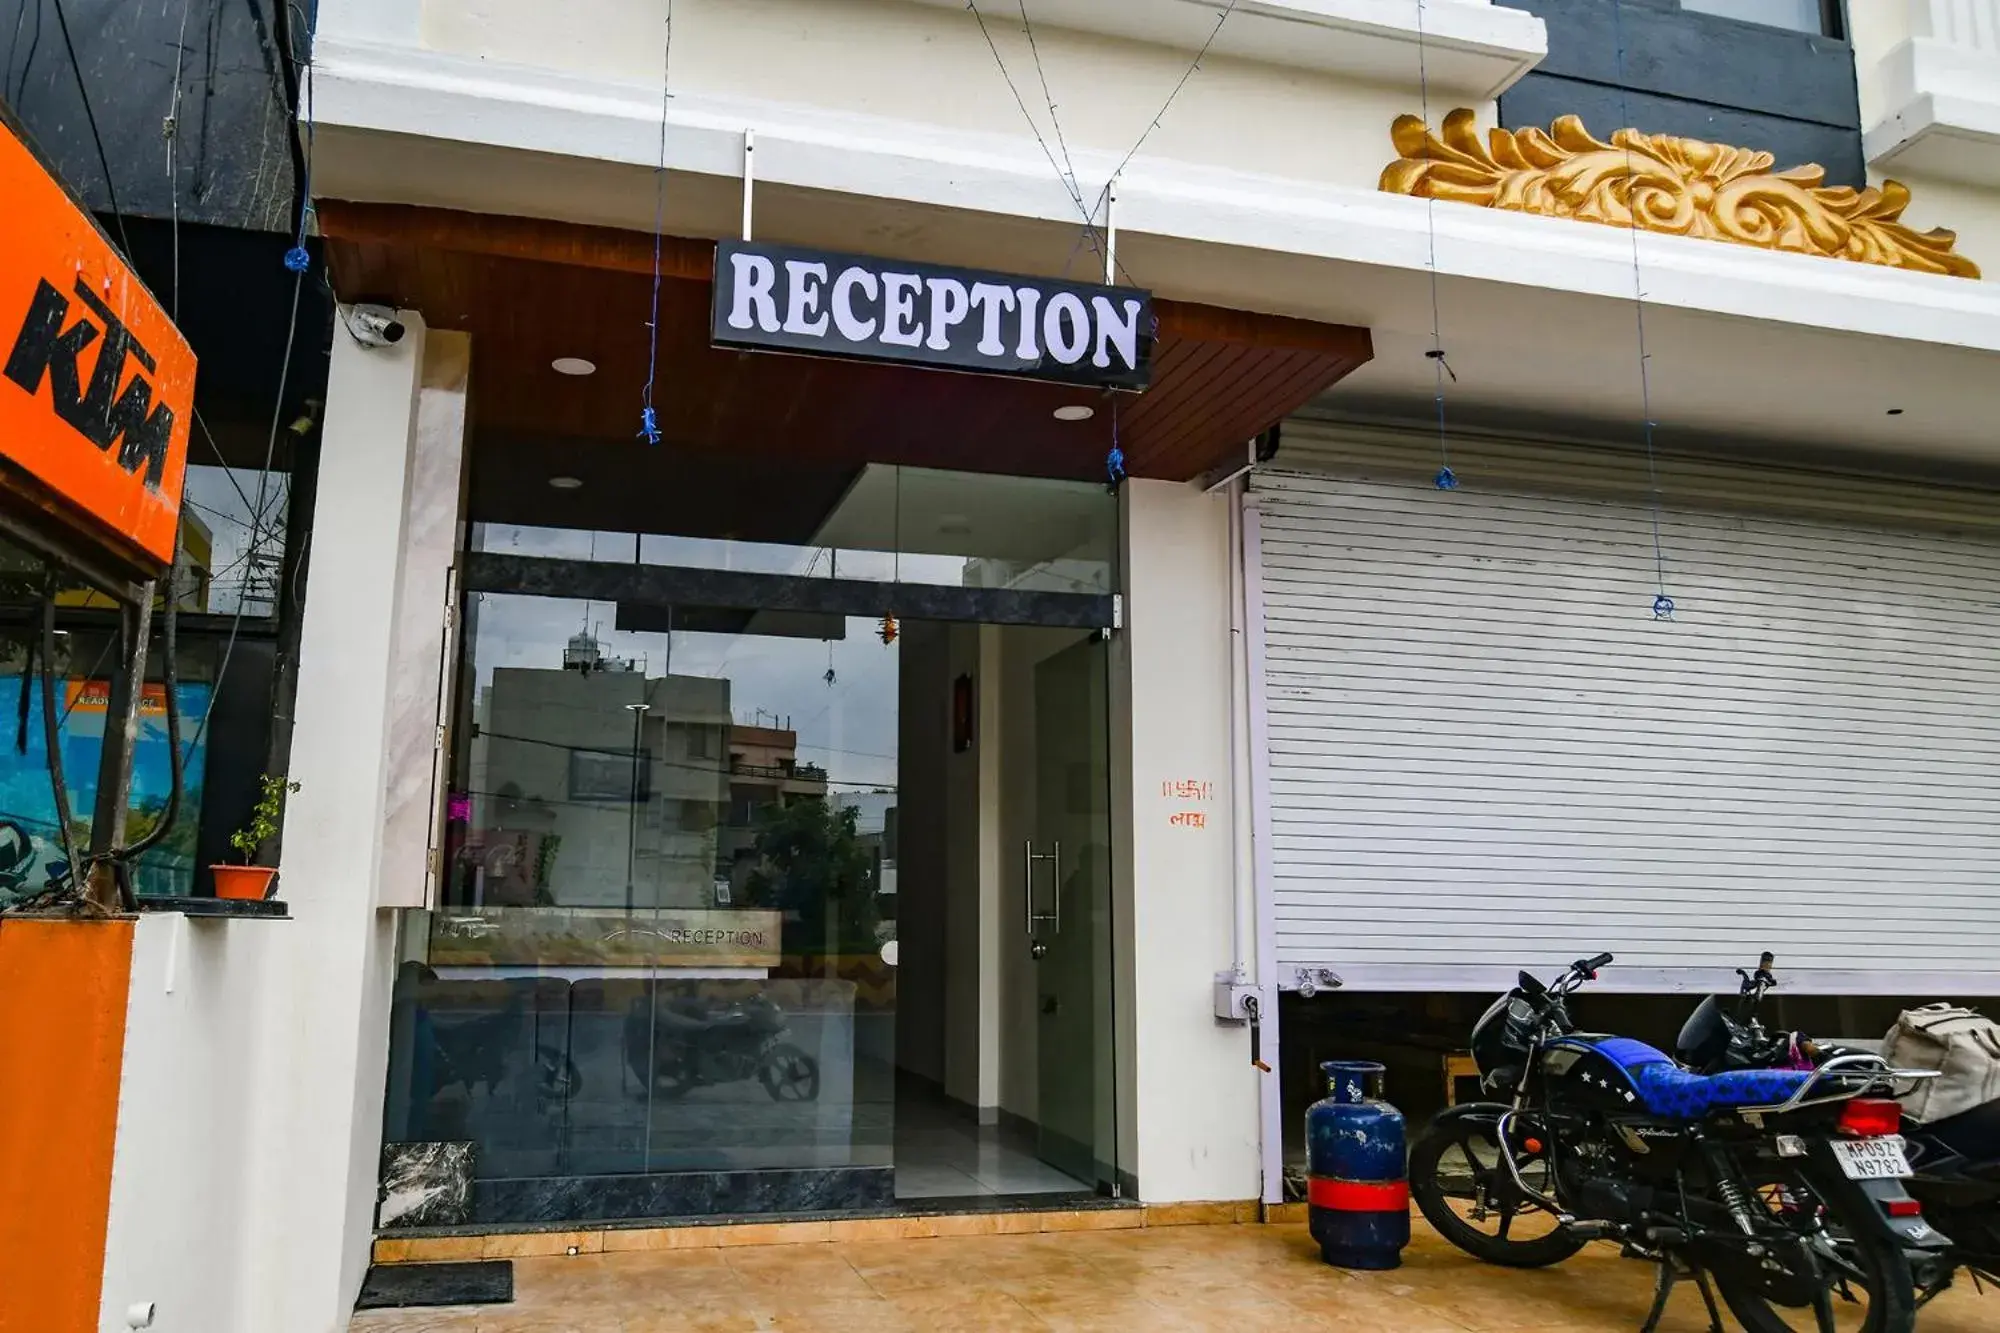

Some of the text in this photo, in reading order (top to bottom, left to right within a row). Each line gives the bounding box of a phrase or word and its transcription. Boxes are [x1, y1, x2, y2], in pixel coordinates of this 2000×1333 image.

[727, 252, 1141, 370] RECEPTION
[3, 276, 174, 493] KTM
[671, 929, 763, 945] RECEPTION
[1845, 1141, 1895, 1158] MP09Z
[1854, 1159, 1905, 1175] N9782
